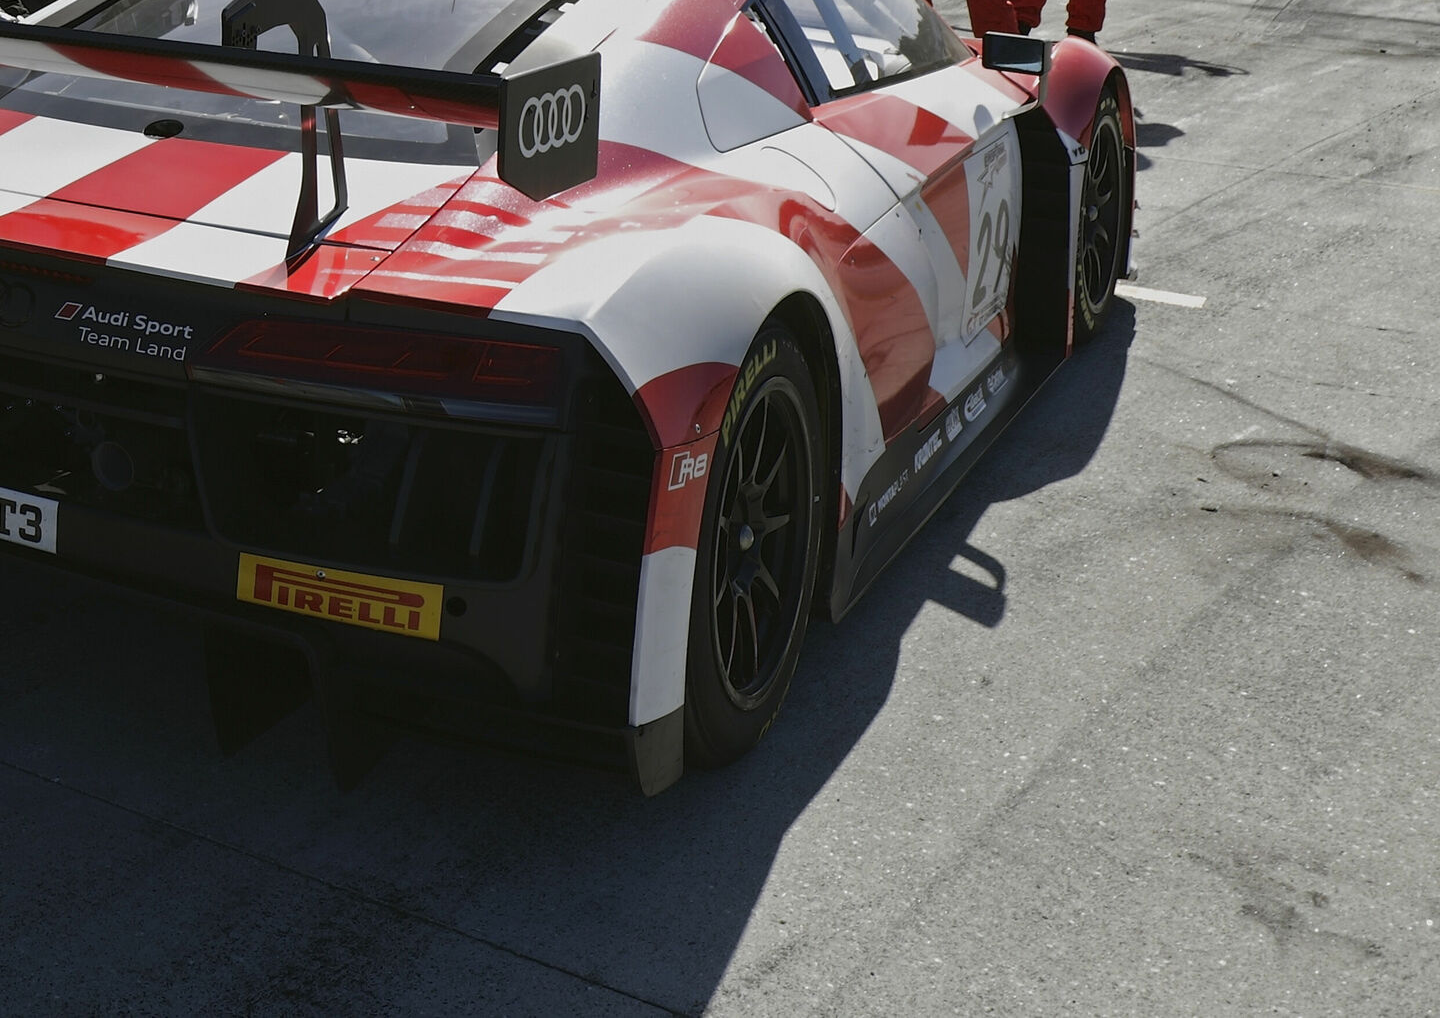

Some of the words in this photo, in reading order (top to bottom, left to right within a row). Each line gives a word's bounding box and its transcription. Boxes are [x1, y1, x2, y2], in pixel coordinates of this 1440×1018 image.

[81, 305, 130, 327] Audi
[133, 314, 194, 340] Sport
[78, 326, 130, 351] Team
[135, 337, 187, 362] Land
[720, 338, 778, 448] PIRELLI
[677, 452, 709, 483] R8
[253, 563, 425, 631] PIRELLI
